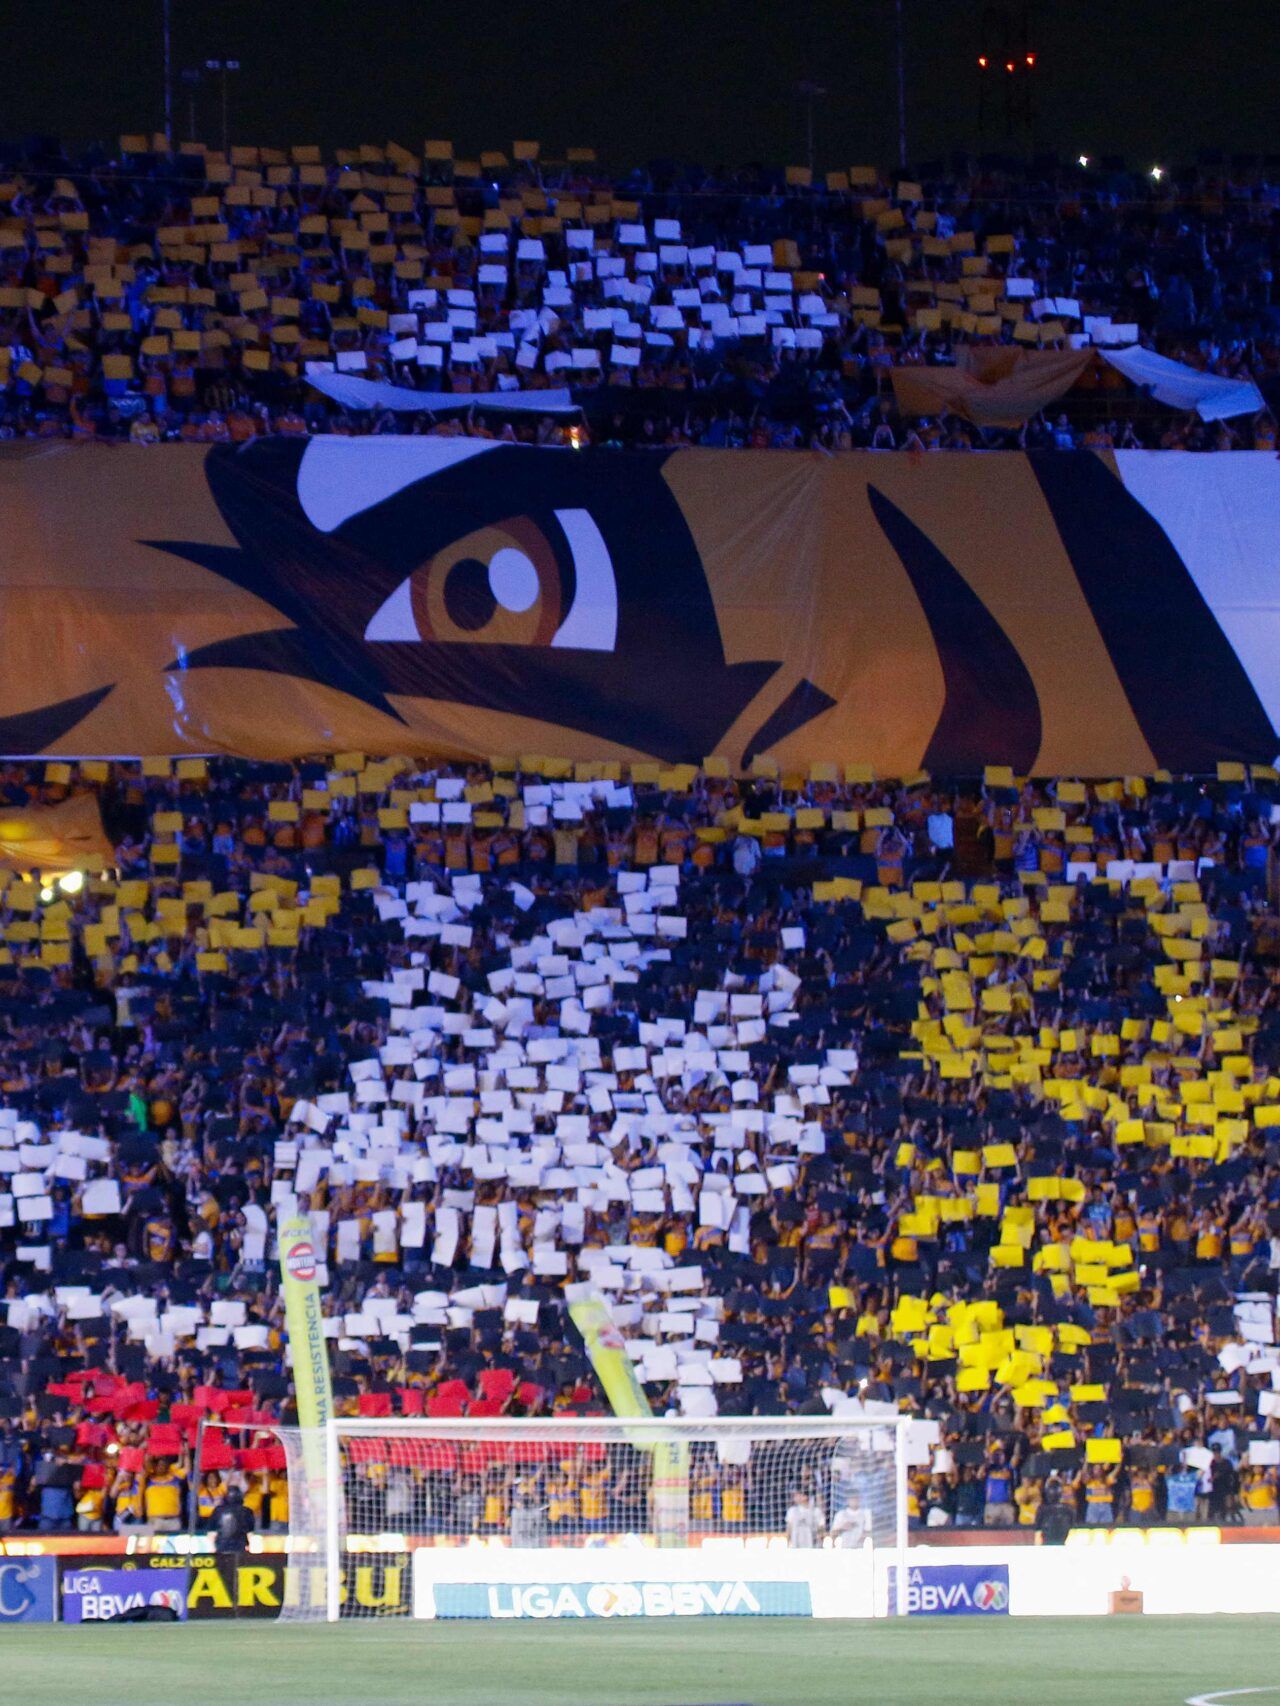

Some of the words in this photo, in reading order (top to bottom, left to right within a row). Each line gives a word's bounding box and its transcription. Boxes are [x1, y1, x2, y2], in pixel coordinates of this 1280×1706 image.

[305, 1292, 326, 1394] RESISTENCIA
[63, 1576, 102, 1595] LIGA
[187, 1566, 402, 1608] ARIBU
[488, 1586, 585, 1618] LIGA
[642, 1581, 761, 1616] BBVA
[907, 1582, 972, 1612] BBVA
[82, 1592, 146, 1620] BBVA
